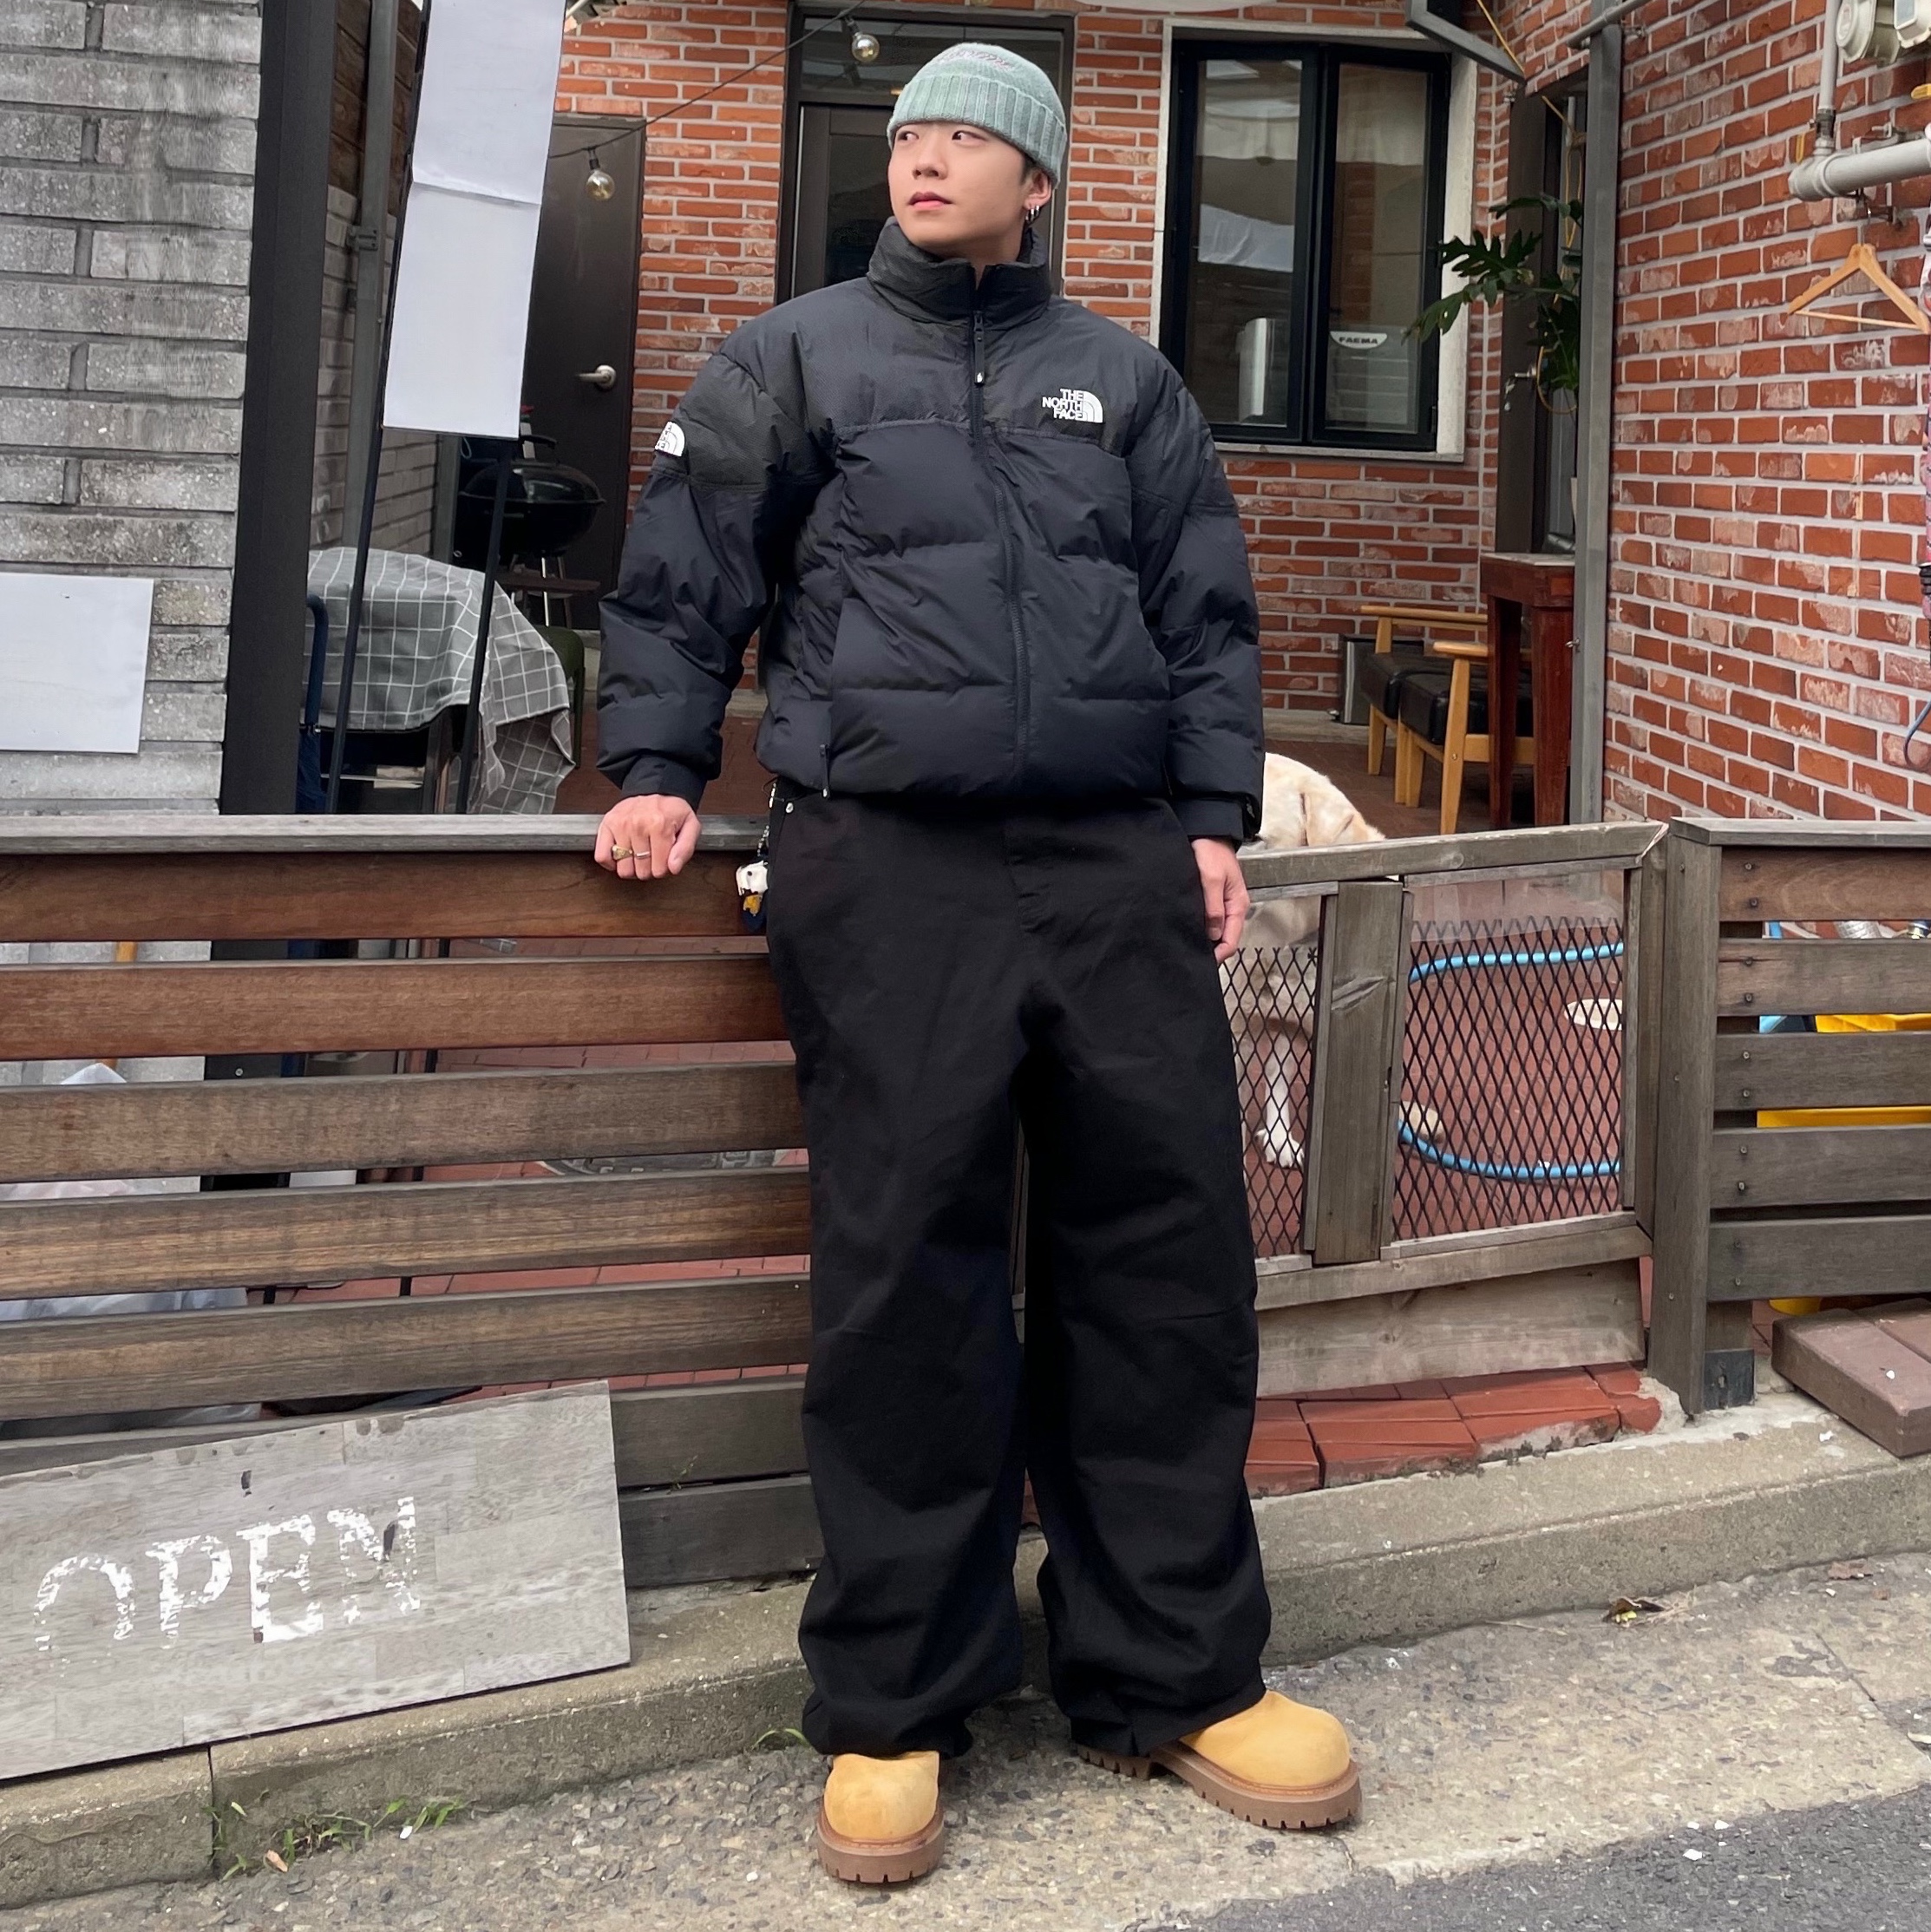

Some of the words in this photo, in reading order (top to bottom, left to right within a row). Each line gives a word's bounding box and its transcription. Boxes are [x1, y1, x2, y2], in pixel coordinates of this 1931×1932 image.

[1060, 389, 1083, 401] THE
[1042, 396, 1083, 411] NORTH
[1053, 408, 1083, 421] FACE
[33, 1496, 421, 1652] OPEN
